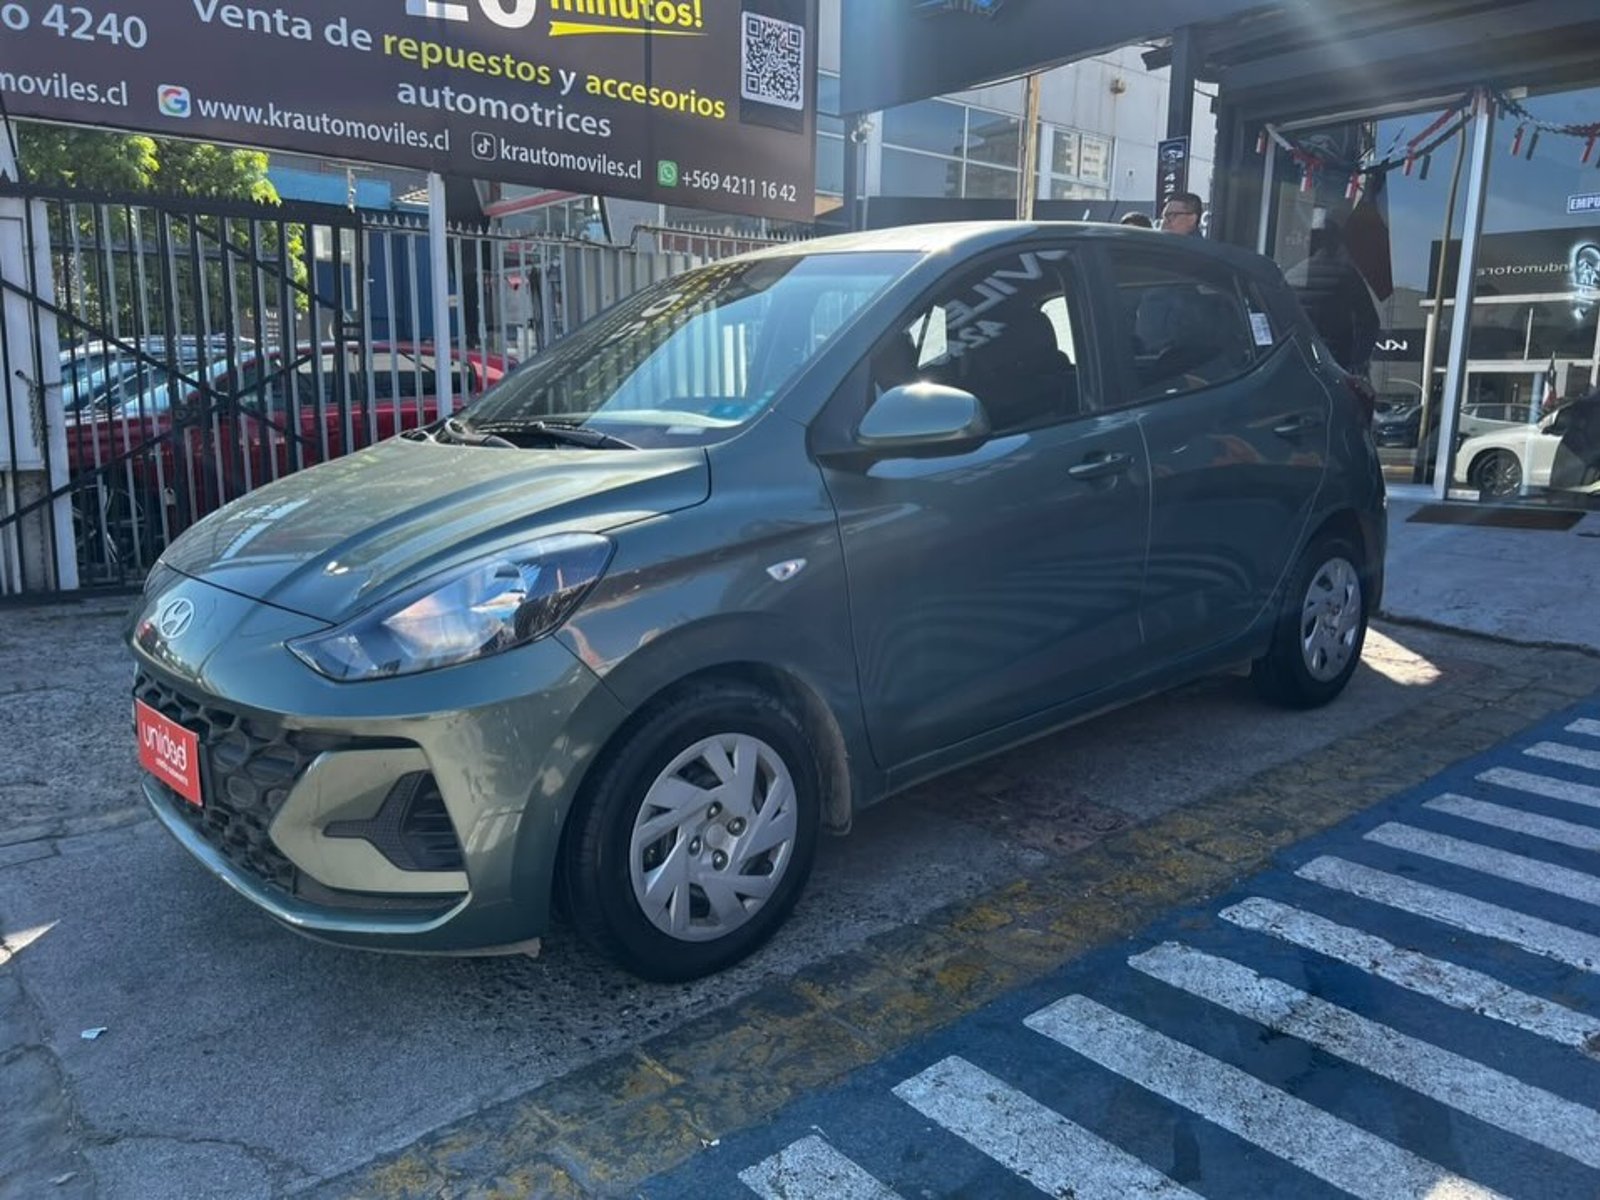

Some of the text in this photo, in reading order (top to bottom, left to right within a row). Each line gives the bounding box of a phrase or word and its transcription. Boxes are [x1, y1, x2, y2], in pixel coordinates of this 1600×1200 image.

[41, 3, 148, 49] 4240
[193, 0, 726, 119] Venta de repuestos y accesorios
[197, 98, 450, 151] www.krautomoviles.cl
[397, 82, 612, 138] automotrices
[500, 138, 642, 180] krautomoviles.cl
[682, 169, 796, 203] +569 4211 16 42
